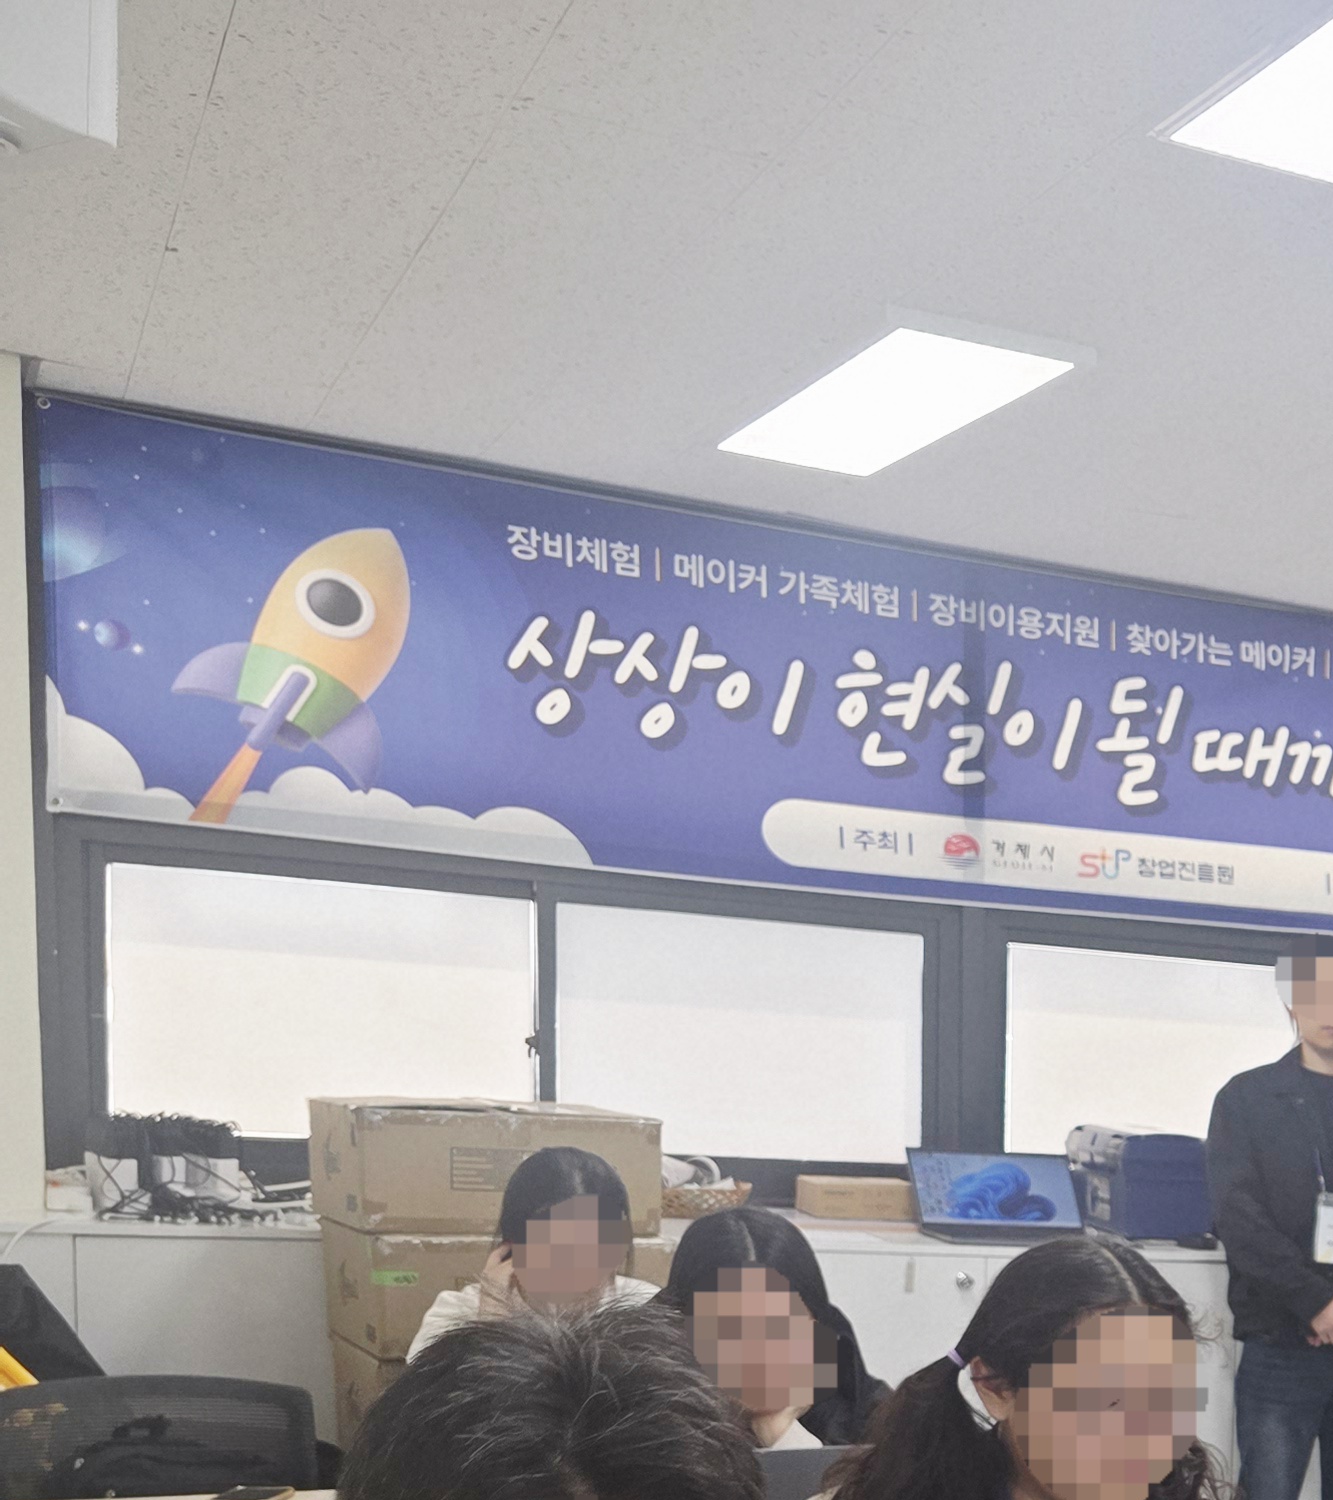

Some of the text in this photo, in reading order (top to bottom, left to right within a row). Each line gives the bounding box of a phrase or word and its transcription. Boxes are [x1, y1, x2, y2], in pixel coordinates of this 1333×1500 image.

[506, 524, 641, 578] 장비체험
[673, 552, 767, 598] 메이커
[778, 568, 900, 619] 가족체험
[928, 593, 1100, 649] 장비이용지원
[1125, 622, 1233, 667] 찾아가는
[1239, 640, 1315, 677] 메이커
[507, 609, 805, 739] 상상이
[834, 648, 1083, 786] 현실이
[1095, 676, 1184, 806] 될
[854, 828, 898, 854] 주최
